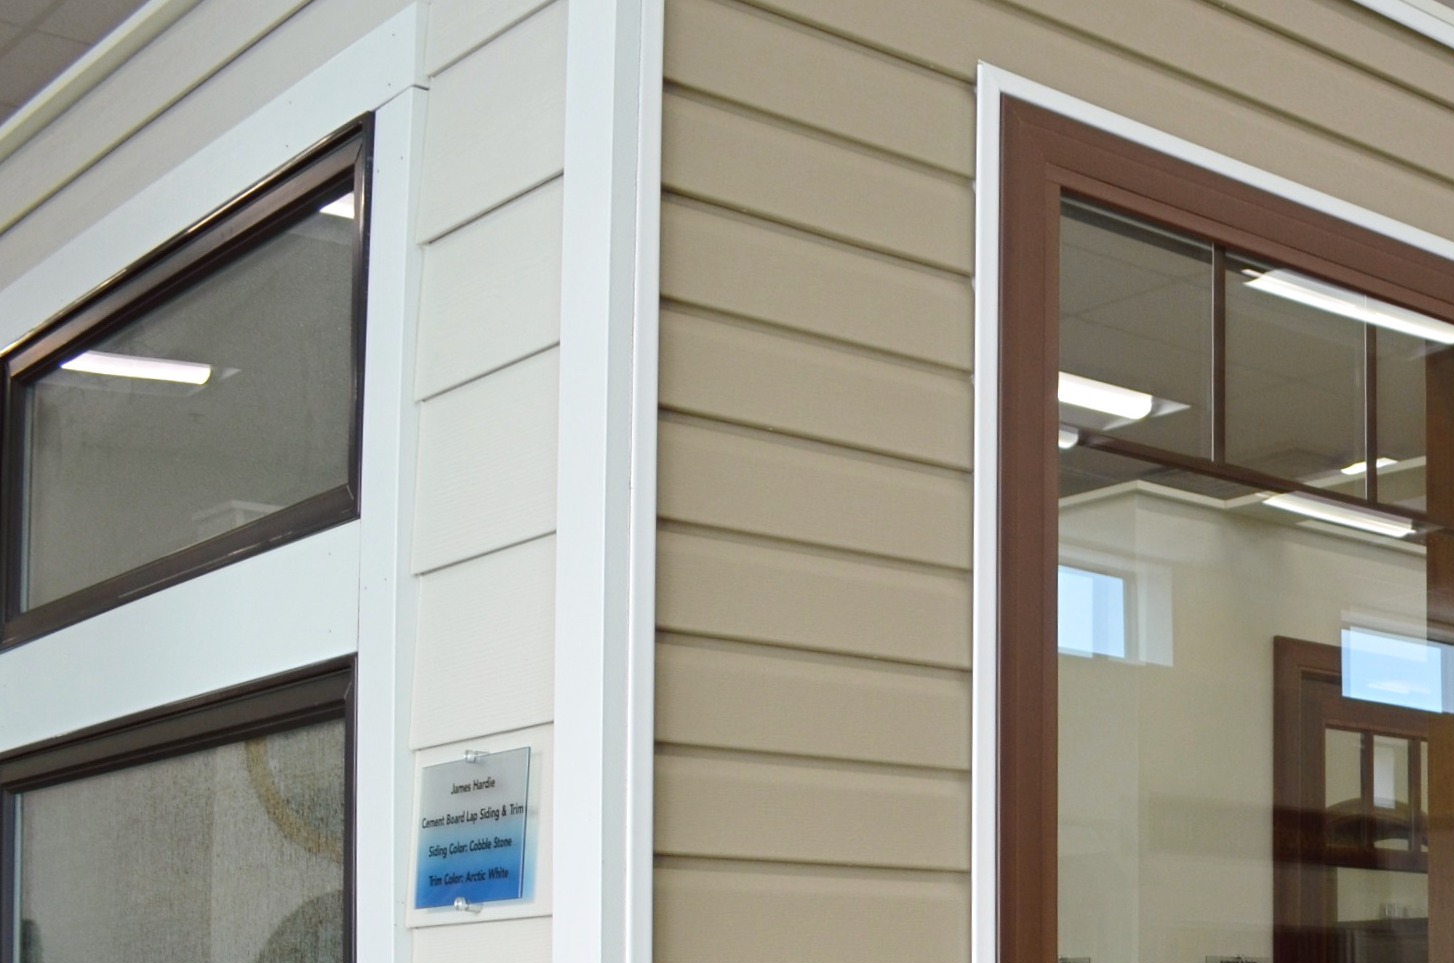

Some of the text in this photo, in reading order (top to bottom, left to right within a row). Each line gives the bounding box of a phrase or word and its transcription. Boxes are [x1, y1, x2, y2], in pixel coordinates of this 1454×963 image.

[450, 776, 496, 795] James Hardie
[421, 803, 524, 829] Cement Board Lap Siding & Trim
[428, 836, 512, 859] Siding Color: Cobble Stone
[428, 874, 443, 887] Trim
[465, 868, 486, 883] Arctic
[488, 866, 509, 880] White
